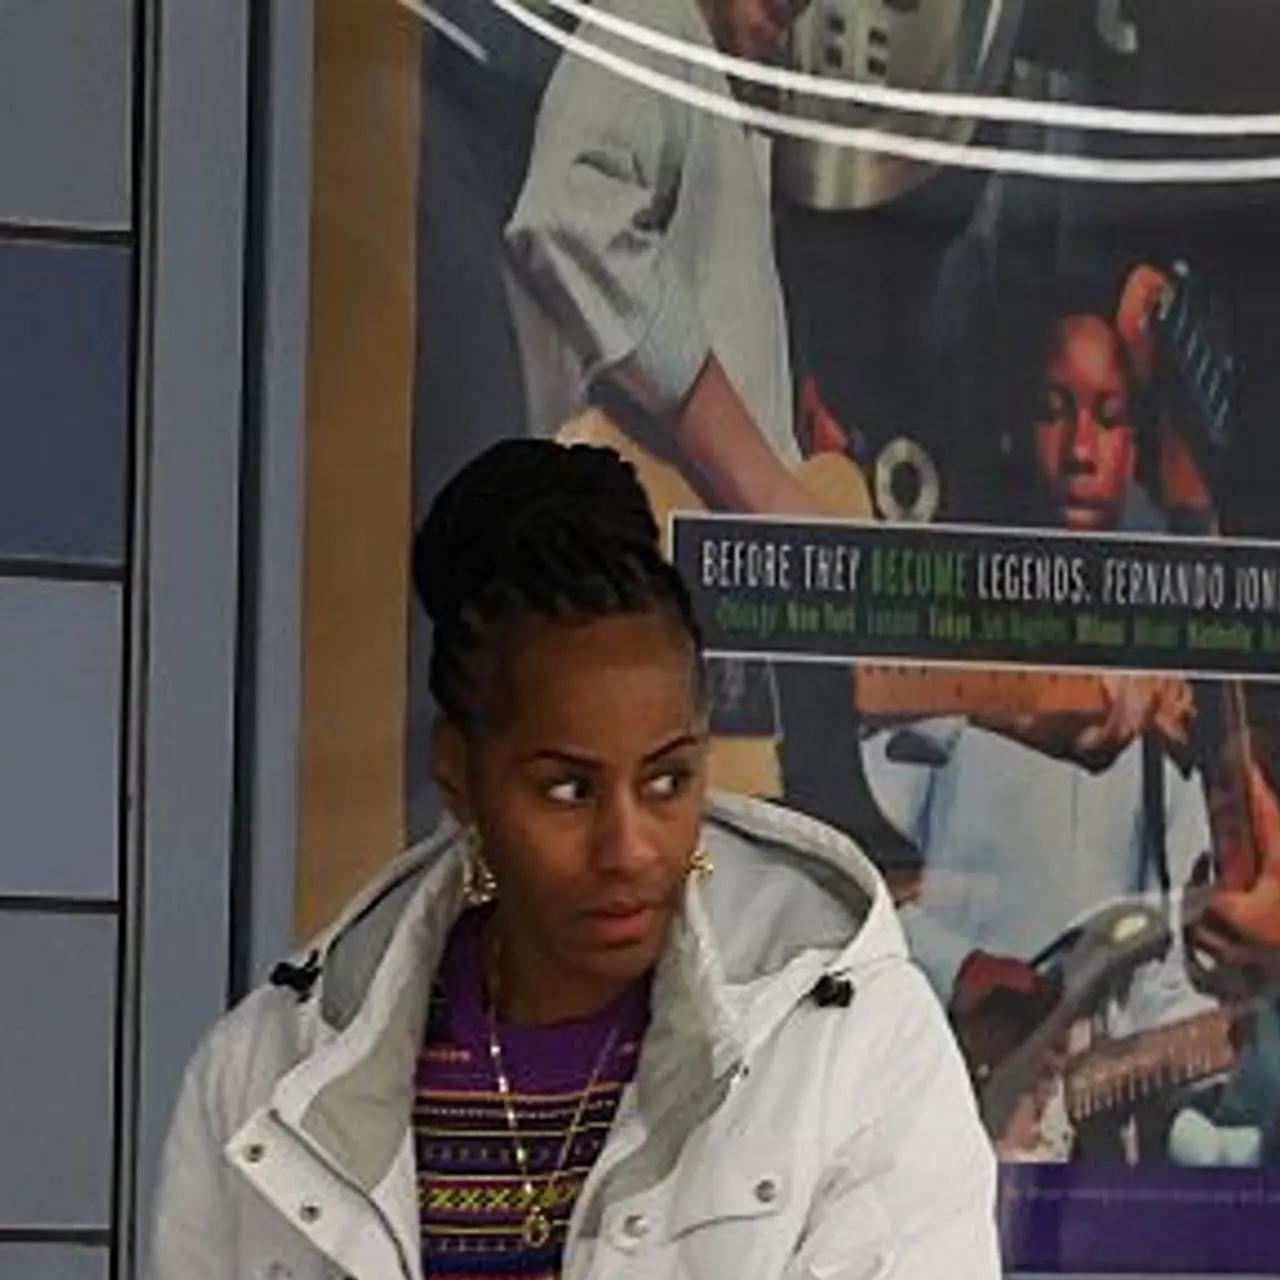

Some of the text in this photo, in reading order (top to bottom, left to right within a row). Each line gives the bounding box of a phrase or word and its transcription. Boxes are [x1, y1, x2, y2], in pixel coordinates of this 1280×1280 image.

[703, 540, 792, 589] BEFORE
[804, 545, 859, 591] THEY
[871, 549, 966, 595] BECOME
[978, 552, 1091, 602] LEGENDS.
[1103, 559, 1225, 610] FERNANDO
